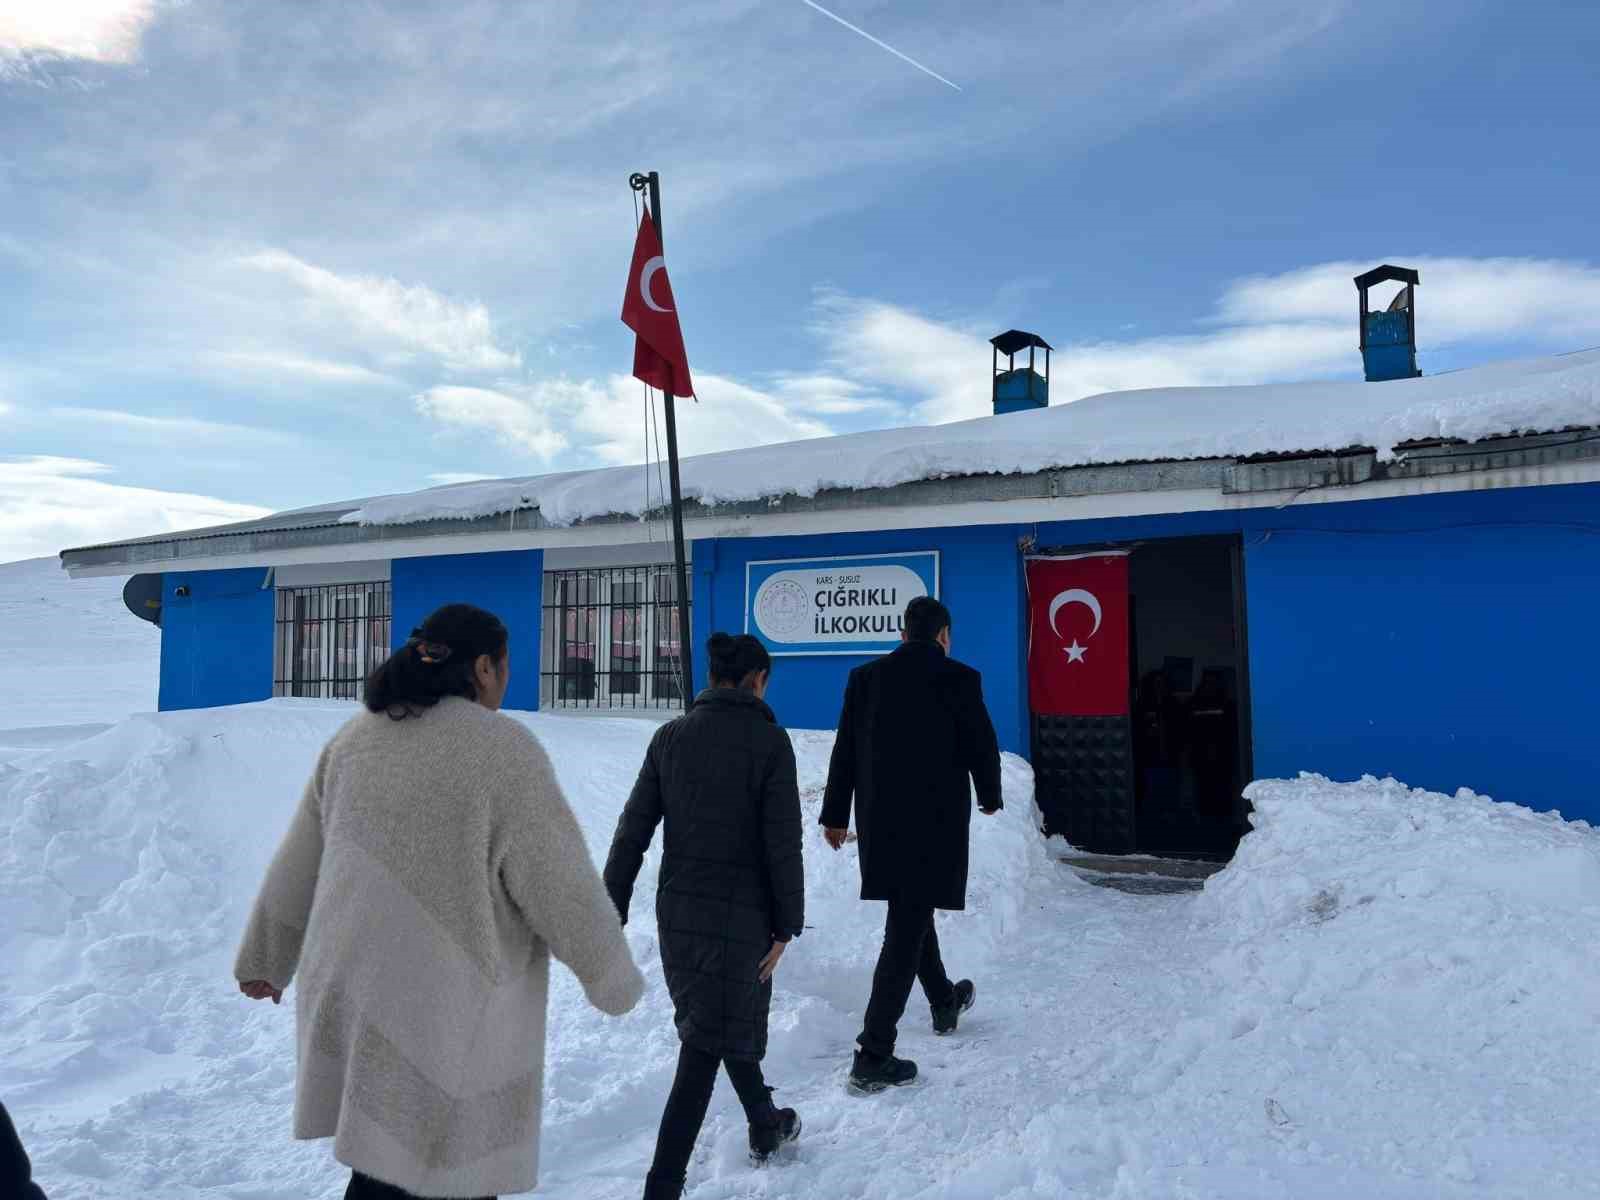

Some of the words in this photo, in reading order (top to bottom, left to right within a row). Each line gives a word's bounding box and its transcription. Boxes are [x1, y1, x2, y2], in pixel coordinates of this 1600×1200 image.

[816, 576, 833, 585] KARS
[839, 575, 861, 584] SUSUZ
[815, 586, 897, 612] ÇIĞRIKLI
